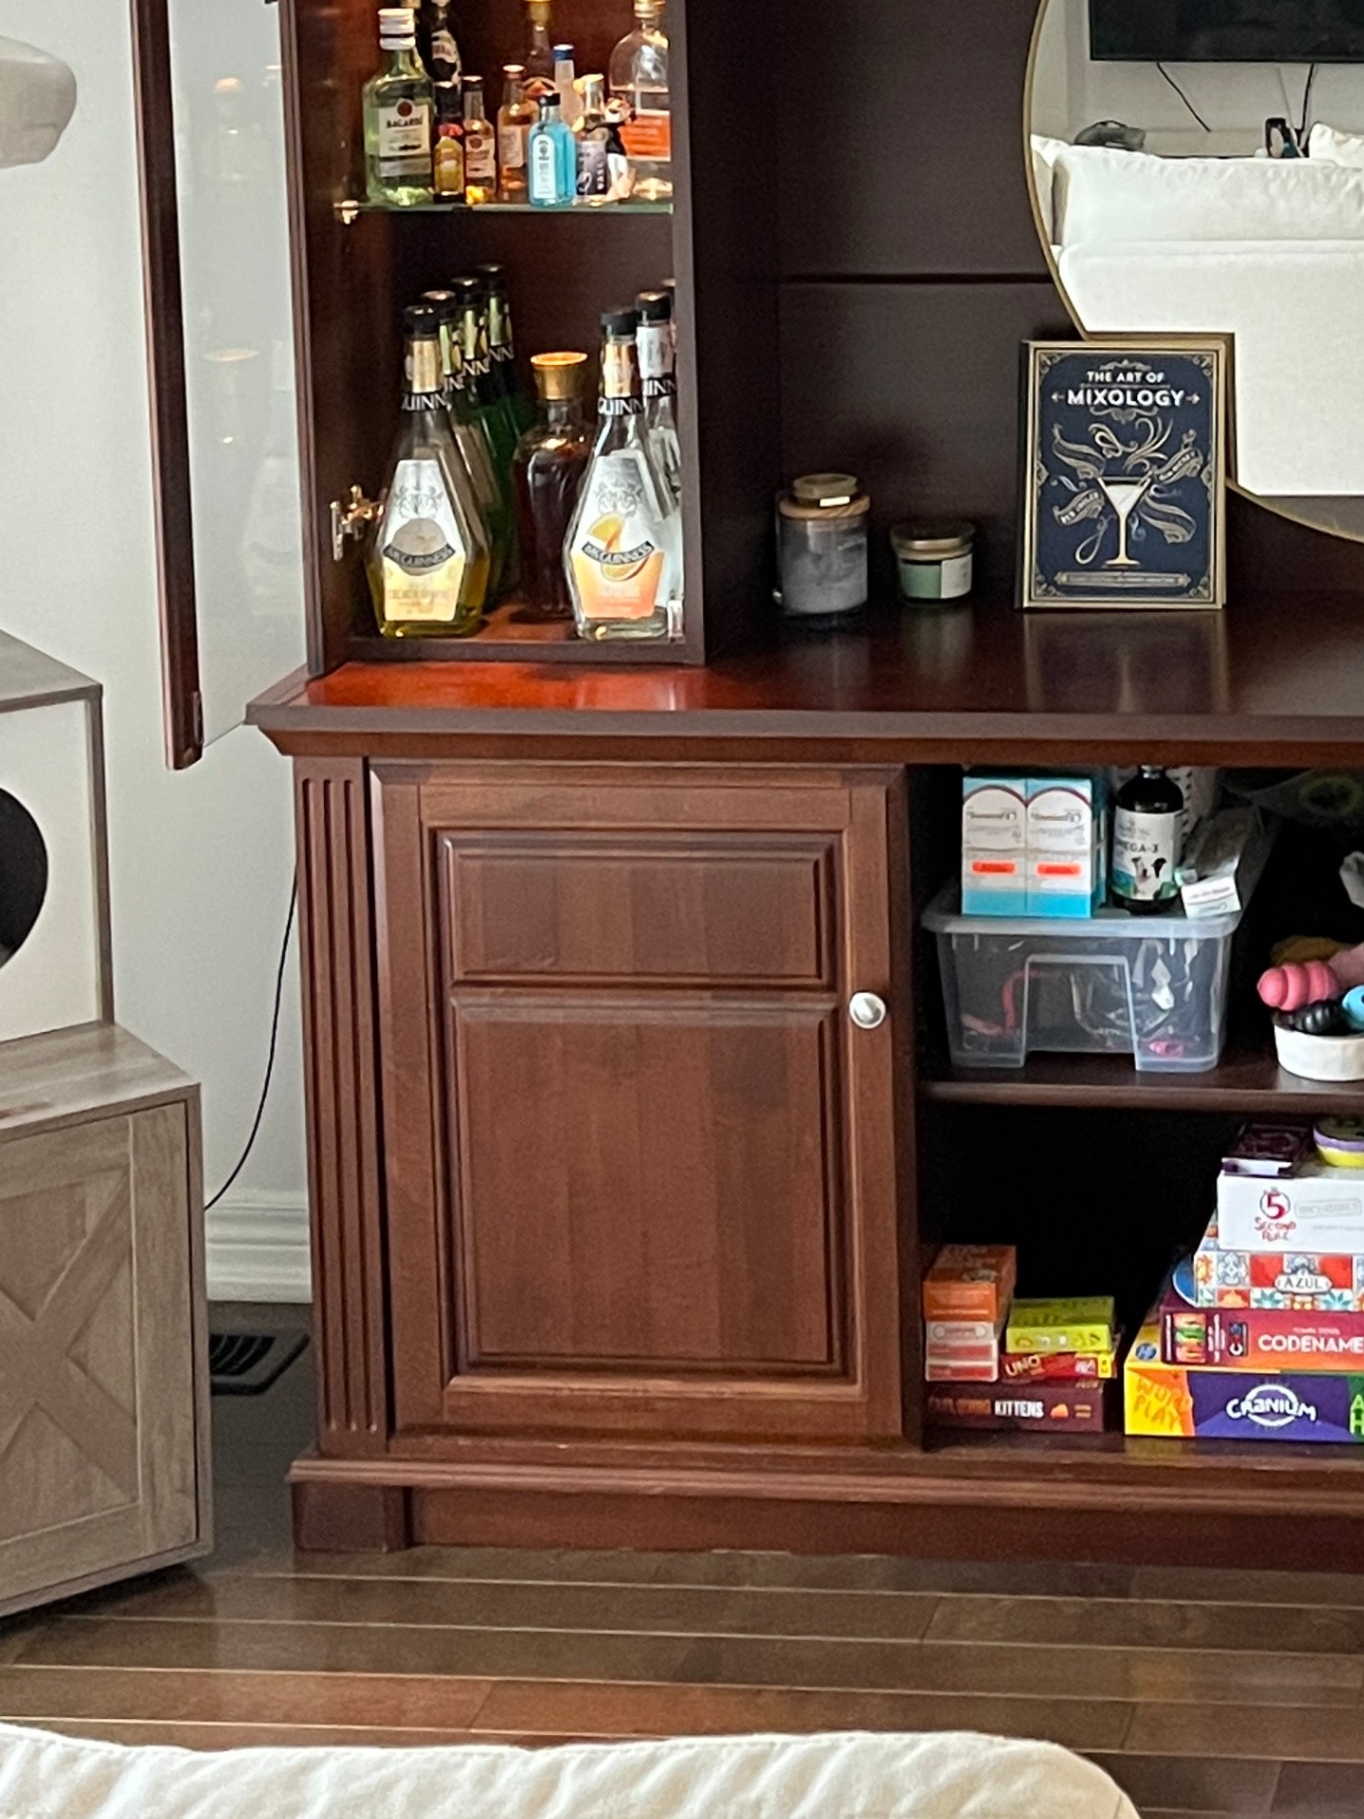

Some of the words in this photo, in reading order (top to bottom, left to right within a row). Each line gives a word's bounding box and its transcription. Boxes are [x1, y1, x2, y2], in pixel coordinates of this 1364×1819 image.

[1087, 371, 1112, 383] THE
[1116, 371, 1143, 383] ART
[1145, 371, 1165, 383] OF
[1067, 389, 1185, 407] MIXOLOGY
[1266, 1191, 1286, 1220] 5
[1283, 1277, 1324, 1291] AZUL
[1005, 1355, 1041, 1377] UNO
[994, 1399, 1044, 1418] KITTENS
